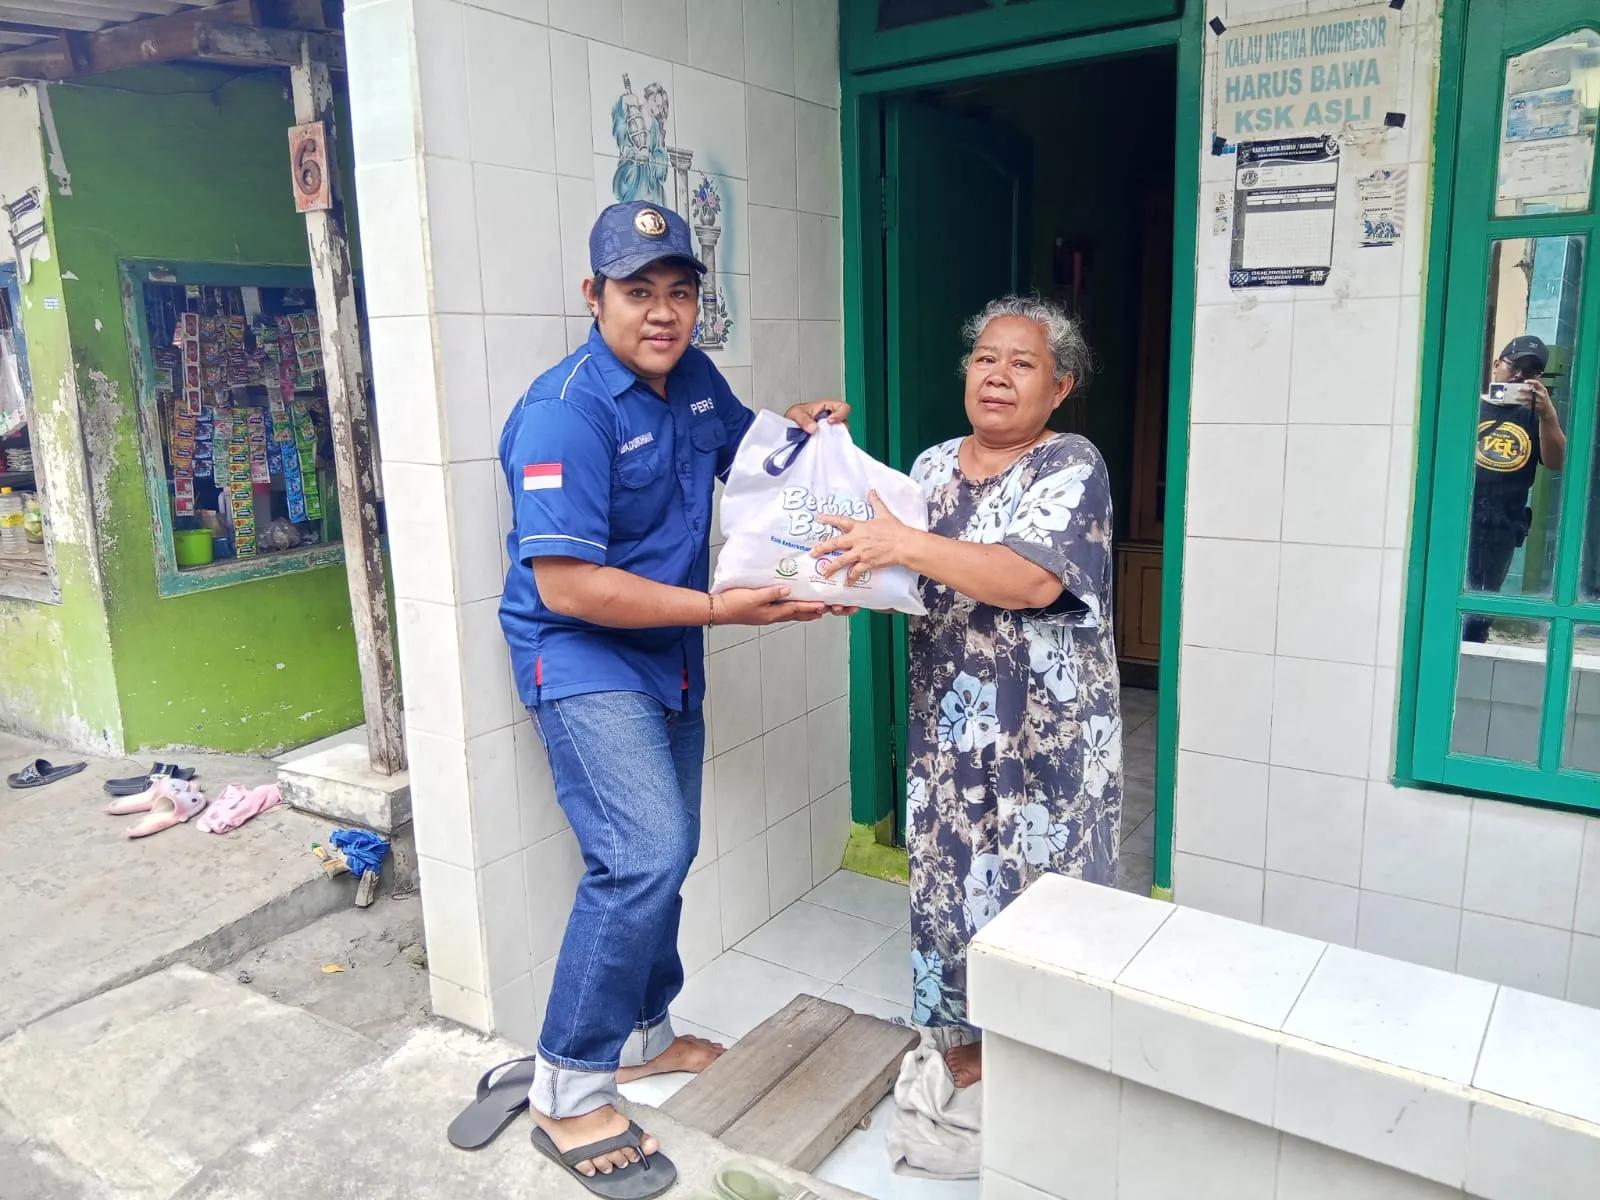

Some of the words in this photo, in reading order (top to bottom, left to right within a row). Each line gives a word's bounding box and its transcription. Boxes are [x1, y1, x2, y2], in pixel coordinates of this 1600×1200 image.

[1225, 34, 1263, 68] KALAU
[1265, 28, 1307, 63] NYEWA
[1310, 16, 1387, 56] KOMPRESOR
[1225, 67, 1303, 104] HARUS
[1310, 58, 1381, 93] BAWA
[1235, 104, 1295, 134] KSK
[1303, 95, 1371, 126] ASLI
[294, 138, 322, 196] 6
[690, 397, 714, 416] PERS
